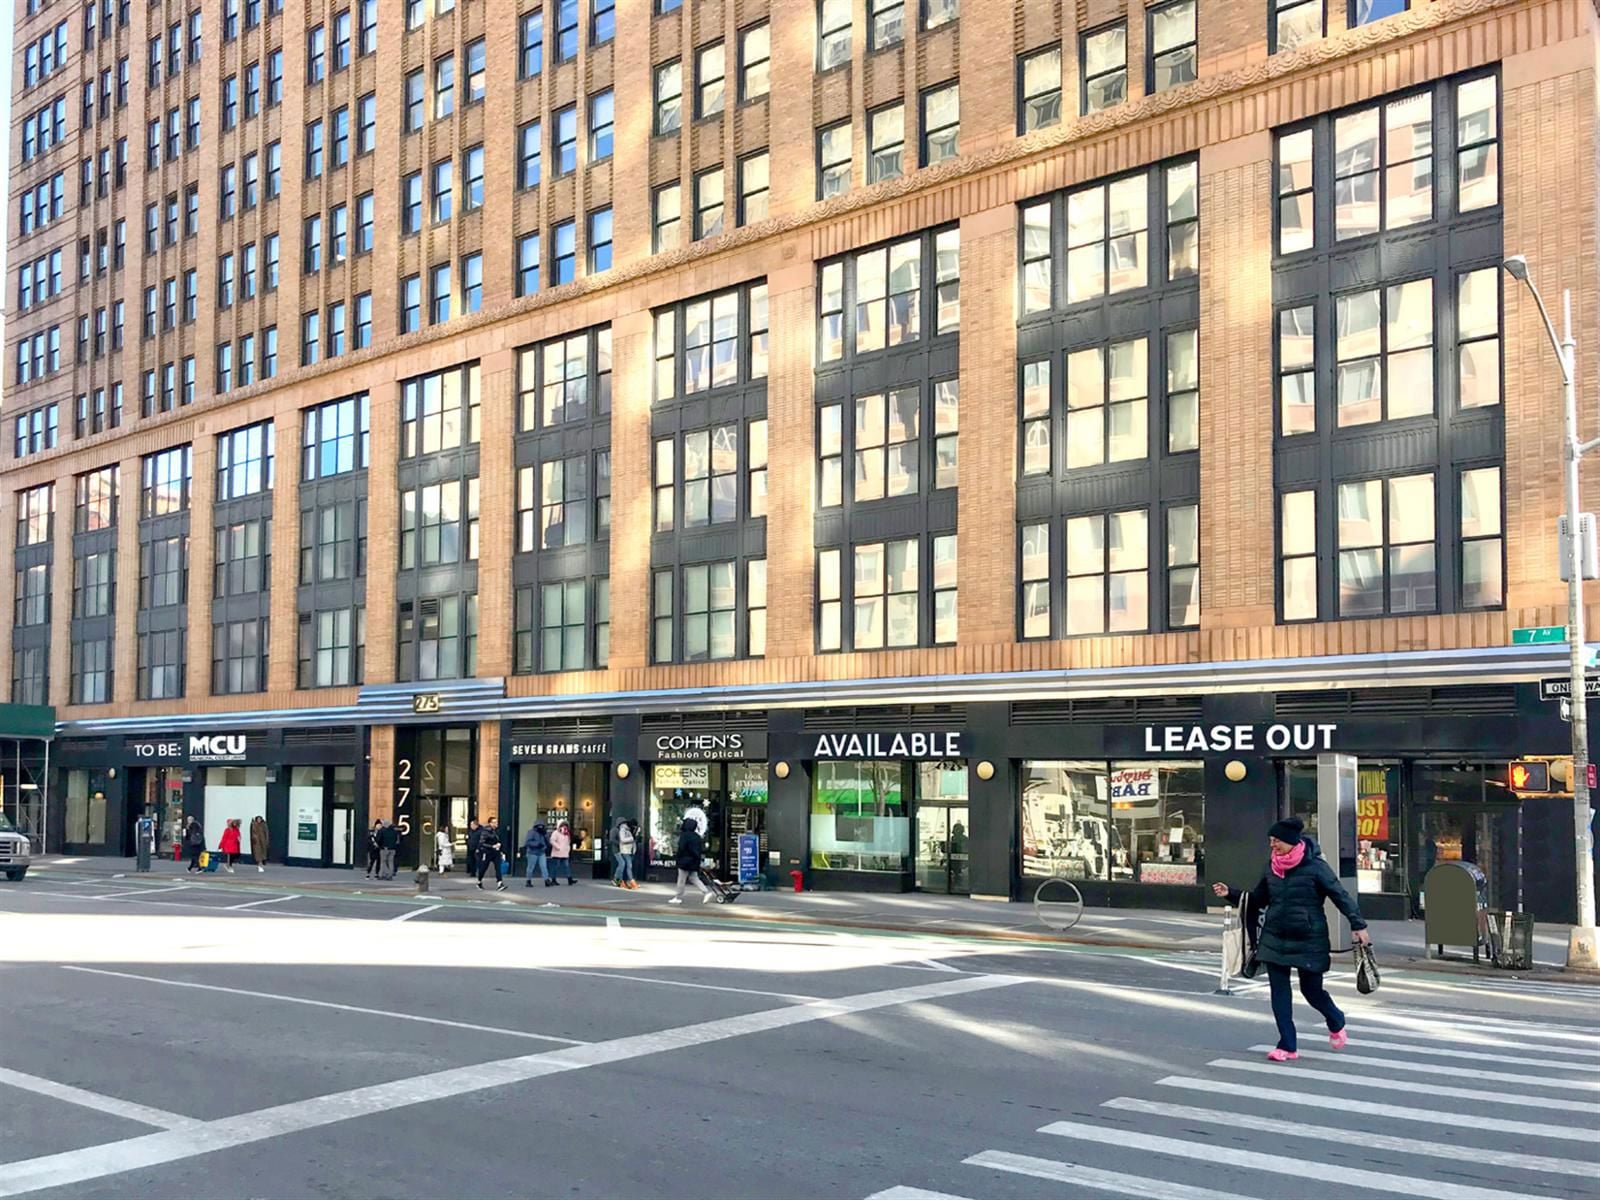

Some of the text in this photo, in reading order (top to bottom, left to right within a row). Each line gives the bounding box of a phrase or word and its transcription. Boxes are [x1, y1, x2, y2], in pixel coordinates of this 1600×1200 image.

[1528, 628, 1552, 642] 7 AV
[1585, 681, 1600, 691] WA
[416, 695, 437, 709] 275
[656, 733, 742, 750] COHEN'S
[814, 732, 961, 757] AVAILABLE
[1145, 724, 1337, 752] LEASE OUT
[134, 735, 246, 757] TO BE: MCU
[512, 744, 544, 755] SEVEN
[546, 743, 580, 754] GRAMS
[658, 750, 744, 760] Fashion Optical
[1357, 799, 1386, 817] UST
